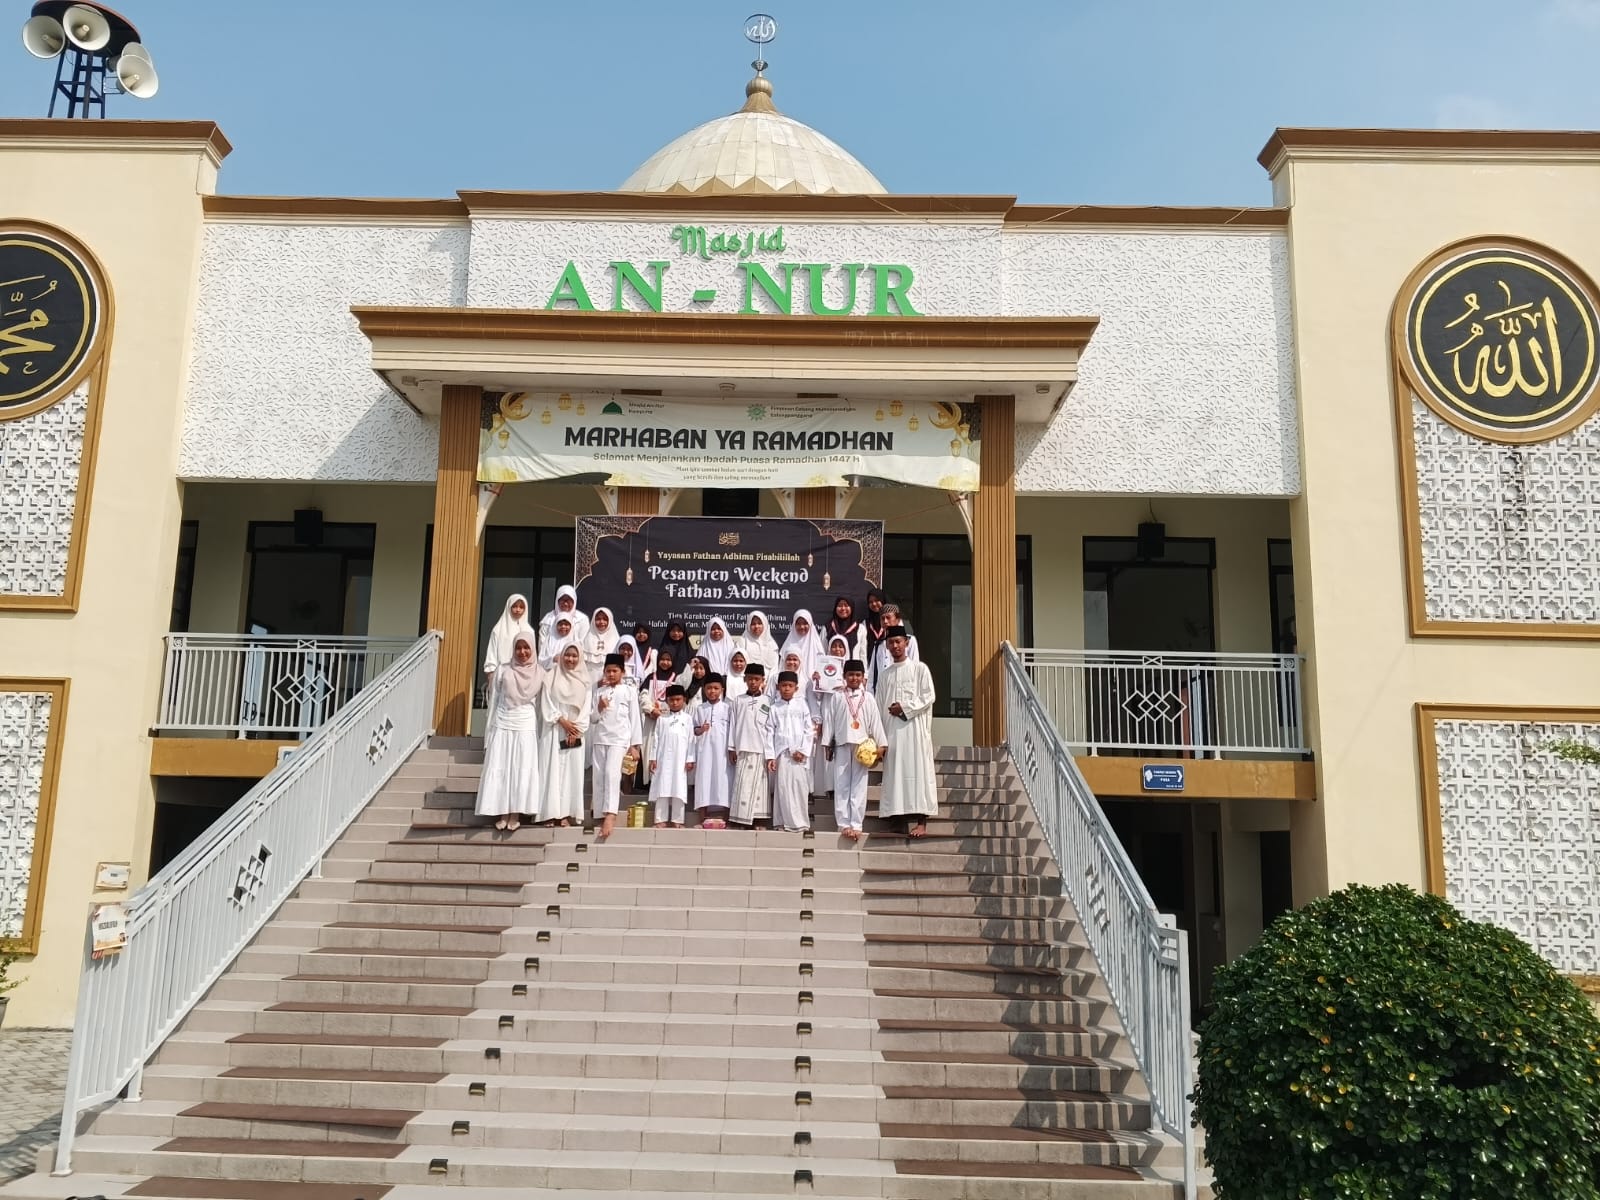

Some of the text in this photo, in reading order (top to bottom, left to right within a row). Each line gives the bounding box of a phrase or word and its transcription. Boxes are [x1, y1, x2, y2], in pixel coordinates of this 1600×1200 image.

[672, 225, 786, 259] Masjid
[544, 260, 670, 313] AN
[737, 262, 925, 316] NUR
[565, 427, 894, 451] MARHABAN YA RAMADHAN
[593, 453, 635, 461] Selamat
[637, 454, 701, 463] Menjalankan
[704, 455, 737, 463] Ibadah
[740, 456, 770, 464] Puasa
[773, 456, 827, 464] Ramadhan
[658, 551, 801, 561] Yayasan Fathan Adhima Fisabilillah
[648, 565, 809, 584] Pesantren Weekend
[665, 583, 790, 600] Fathan Adhima
[683, 612, 712, 620] Karakter
[766, 614, 787, 622] dhima
